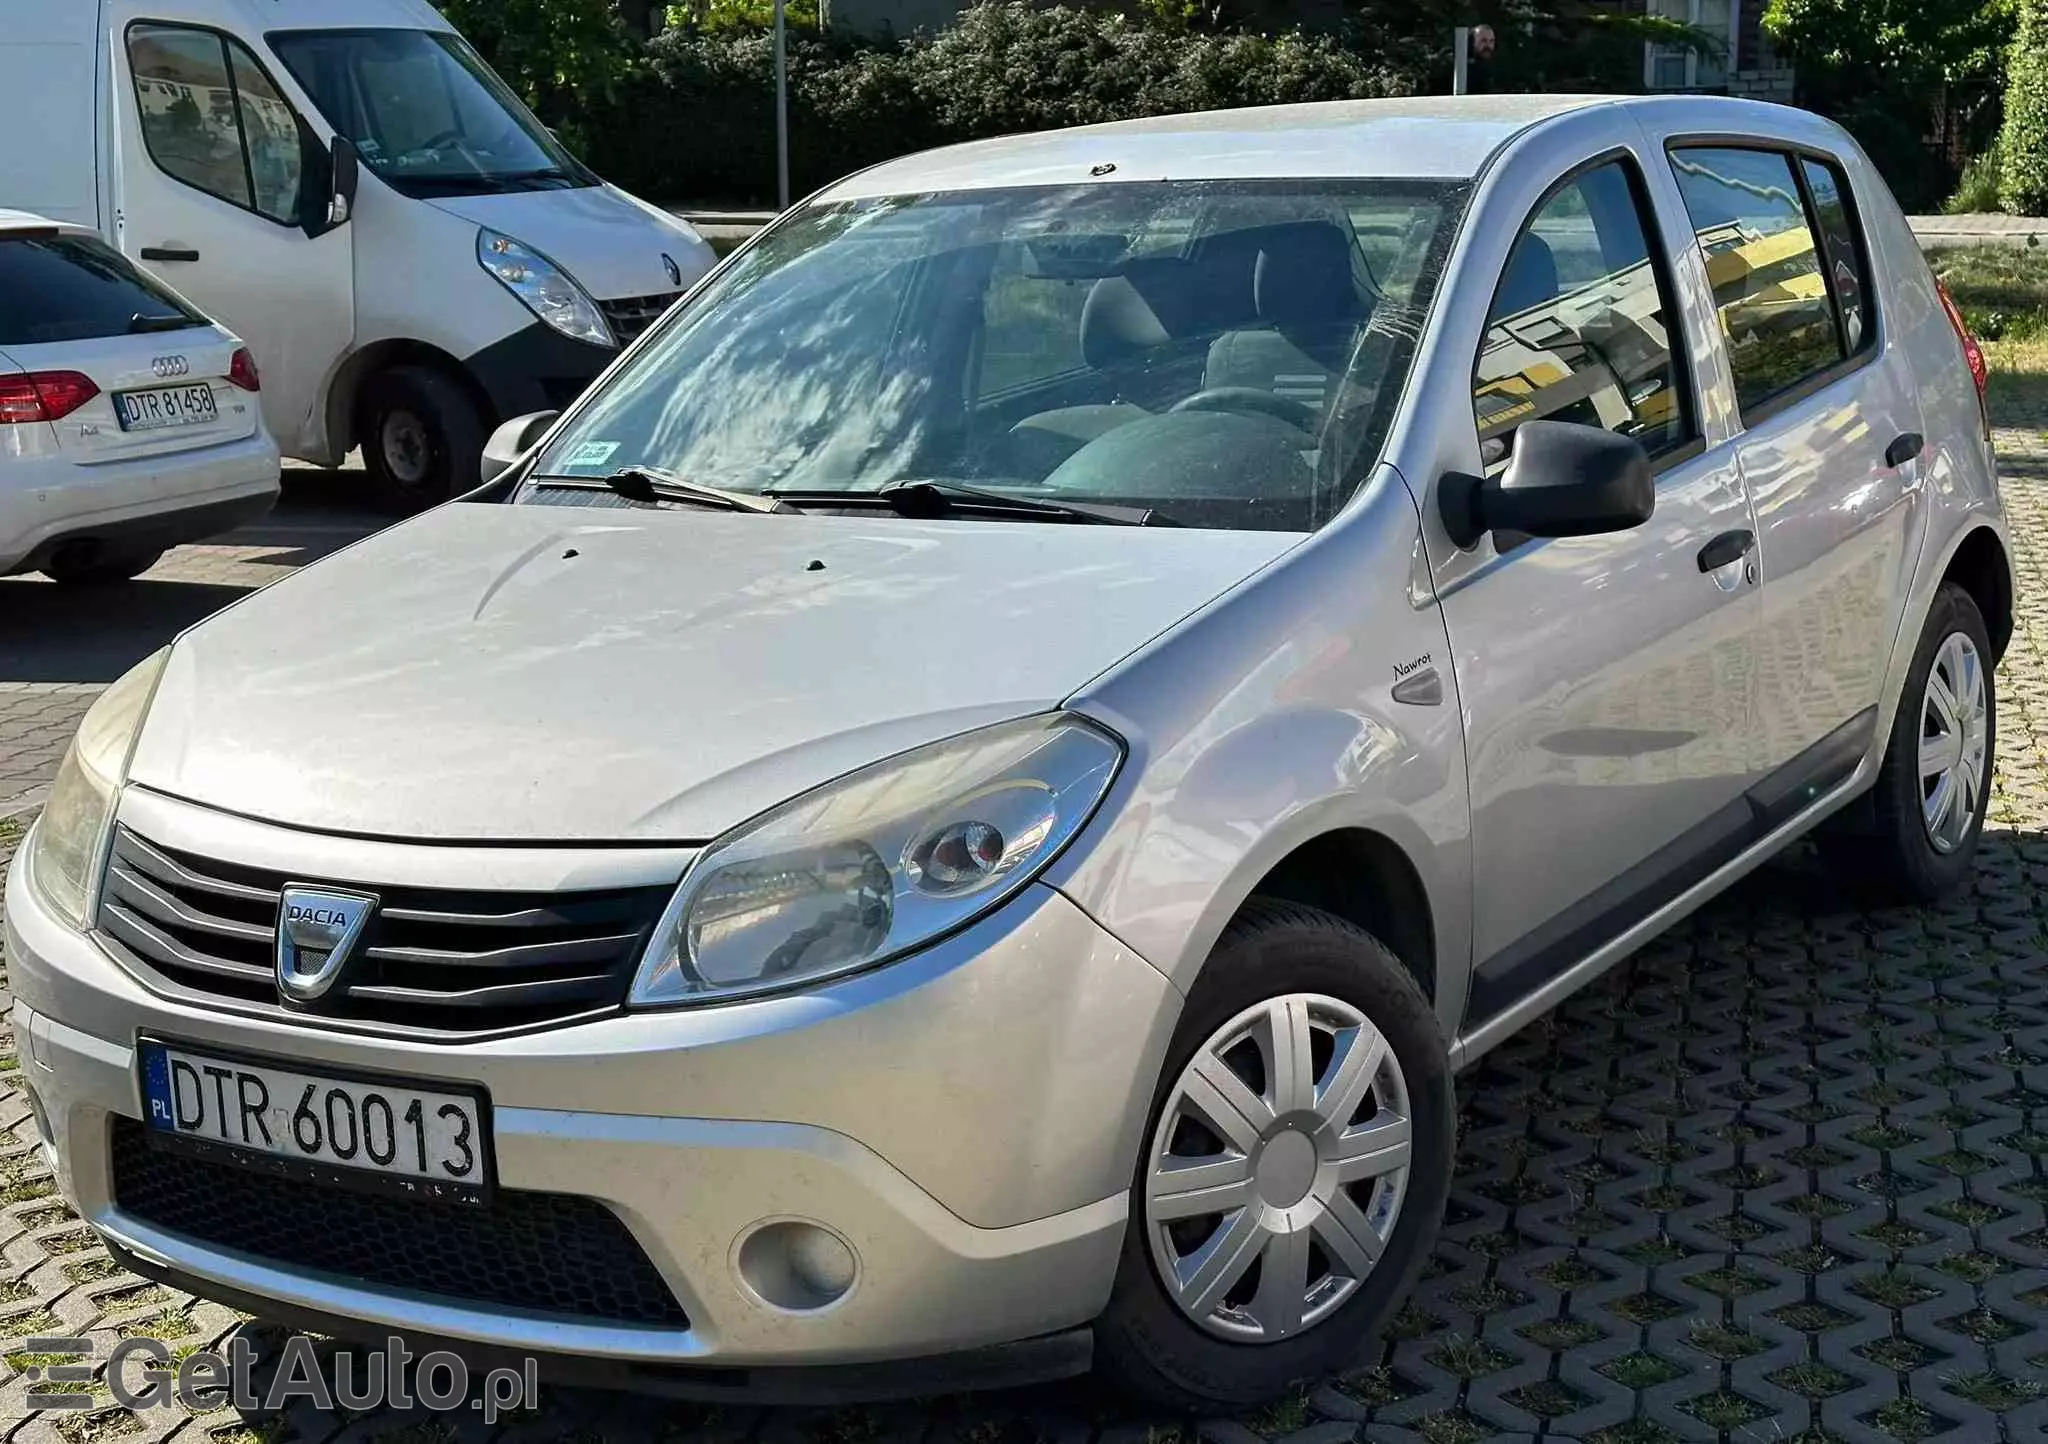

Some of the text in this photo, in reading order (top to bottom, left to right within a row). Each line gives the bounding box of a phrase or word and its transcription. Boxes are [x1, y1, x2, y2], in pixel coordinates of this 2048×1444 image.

[126, 393, 162, 422] DTR
[162, 388, 212, 416] 81458
[1393, 652, 1432, 681] Nawrot
[288, 905, 346, 927] DACIA
[151, 1098, 171, 1121] PL
[170, 1059, 474, 1177] DTR 60013
